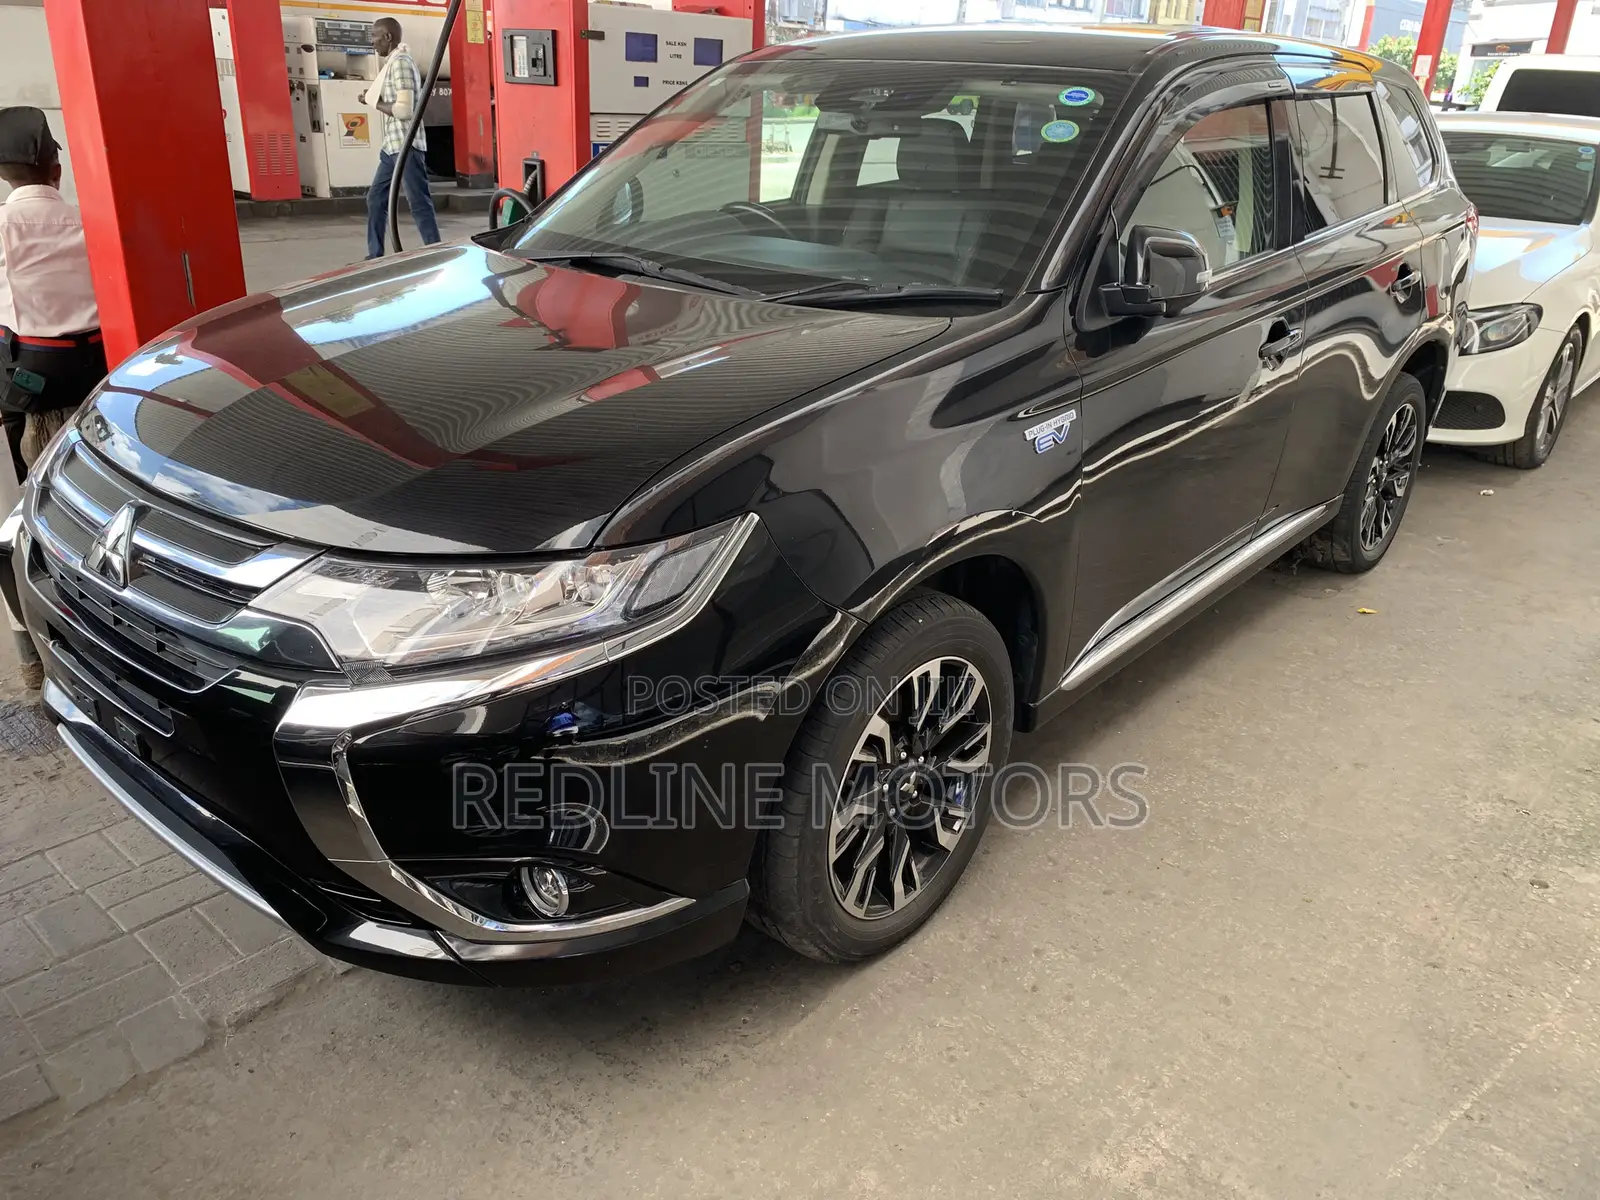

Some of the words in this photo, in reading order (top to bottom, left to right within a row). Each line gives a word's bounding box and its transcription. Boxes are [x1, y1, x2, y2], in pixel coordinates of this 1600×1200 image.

[1028, 422, 1053, 438] PLUG-IN
[1053, 412, 1074, 426] HYBRID
[1036, 423, 1069, 453] EV
